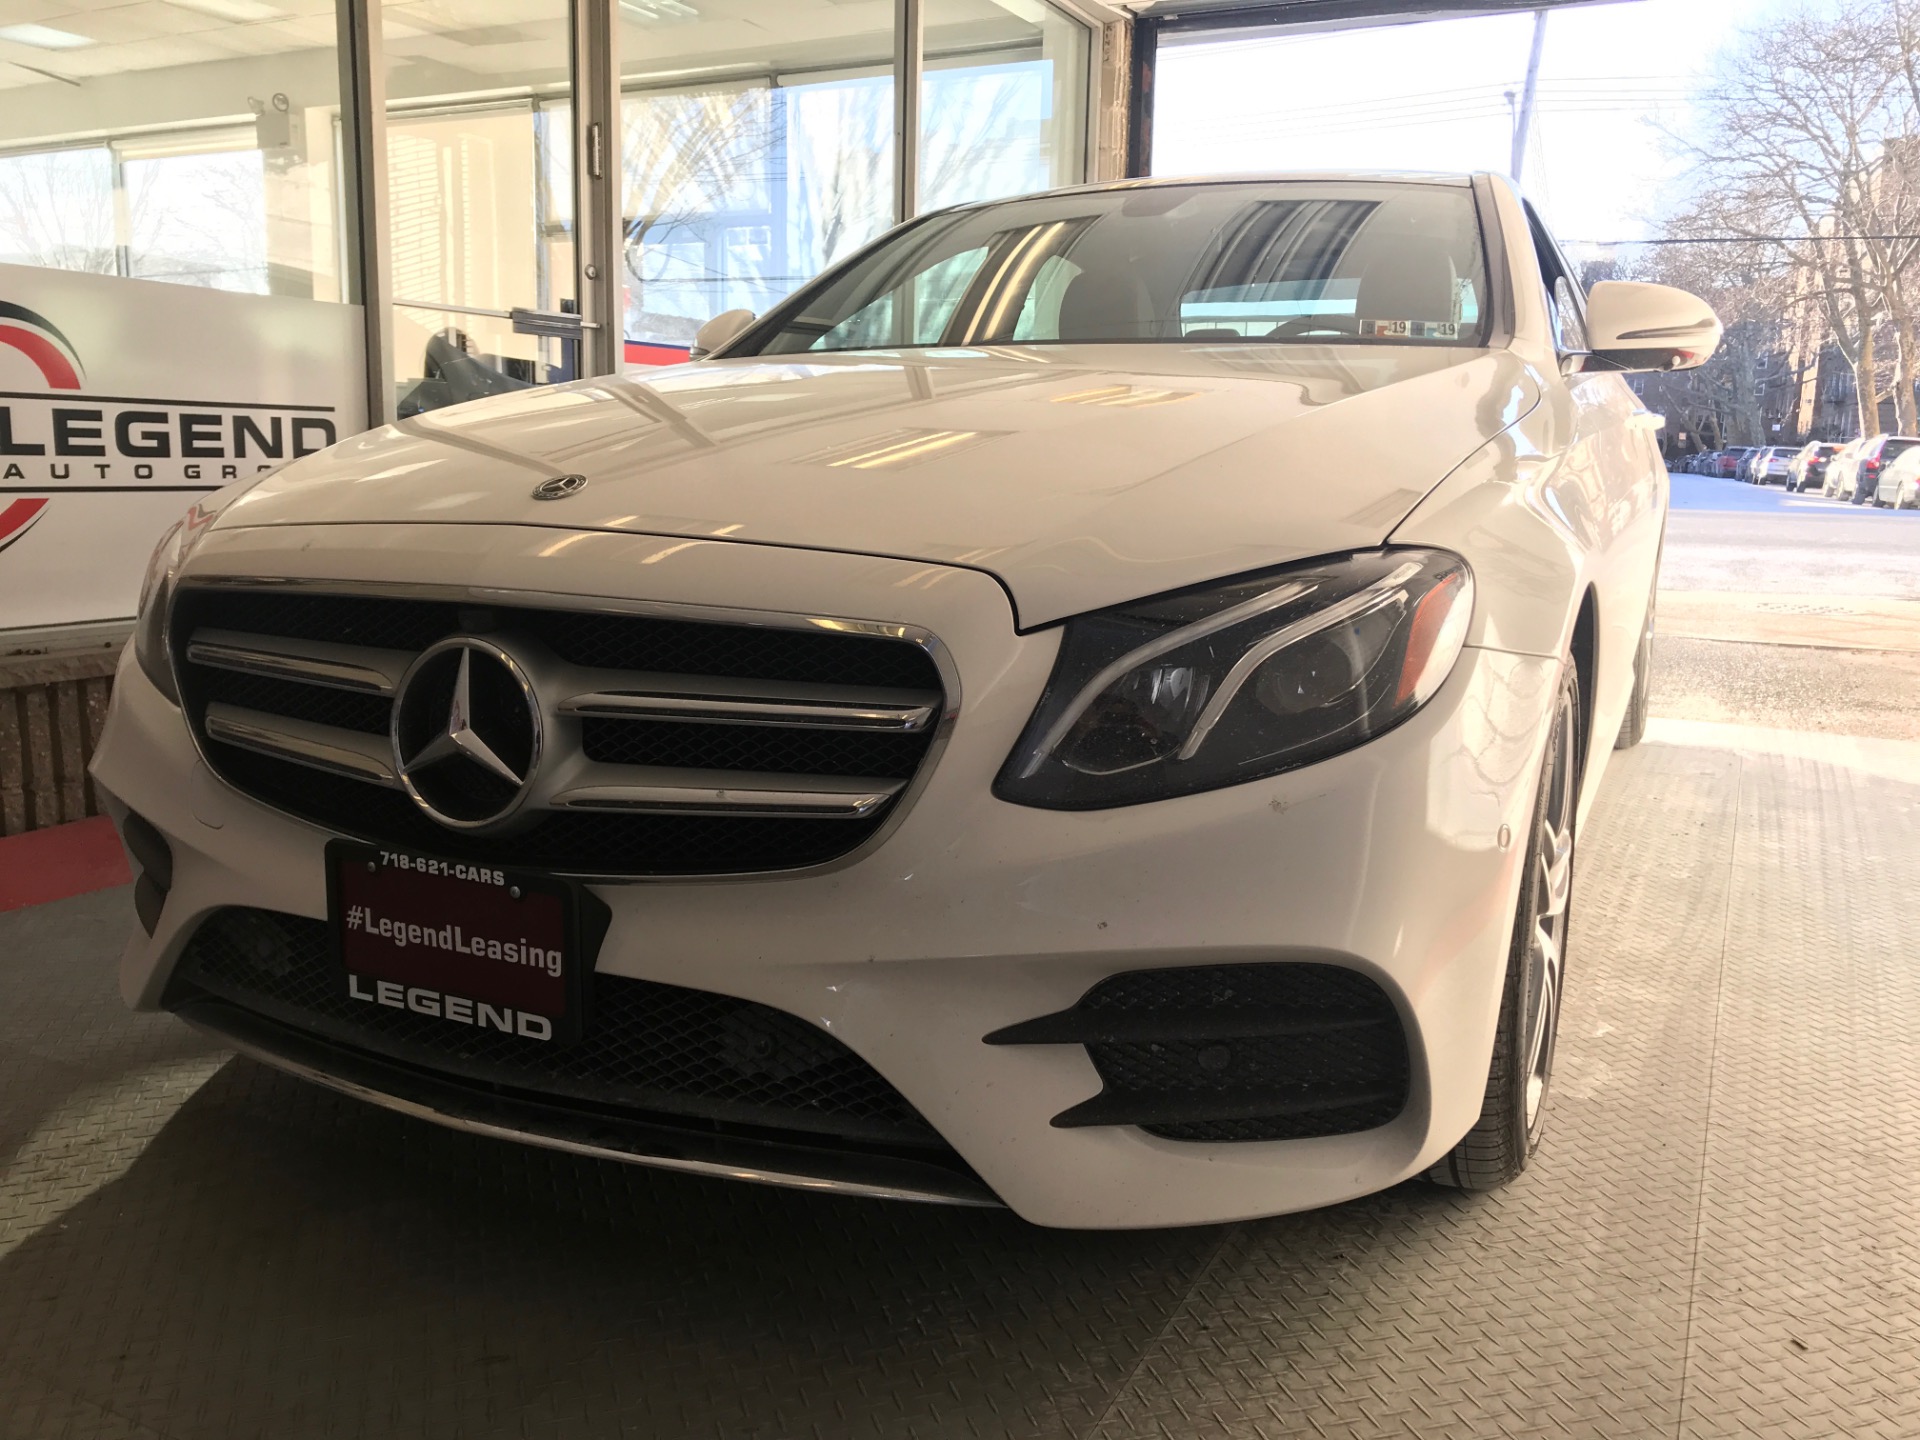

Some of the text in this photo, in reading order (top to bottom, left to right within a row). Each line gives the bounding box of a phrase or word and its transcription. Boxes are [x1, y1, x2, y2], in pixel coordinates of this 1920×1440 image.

[1392, 322, 1406, 333] 19
[1442, 324, 1455, 335] 19
[0, 406, 337, 459] LEGEND
[380, 851, 505, 886] 718-621-CARS
[346, 905, 562, 978] #LegendLeasing
[349, 974, 552, 1041] LEGEND
